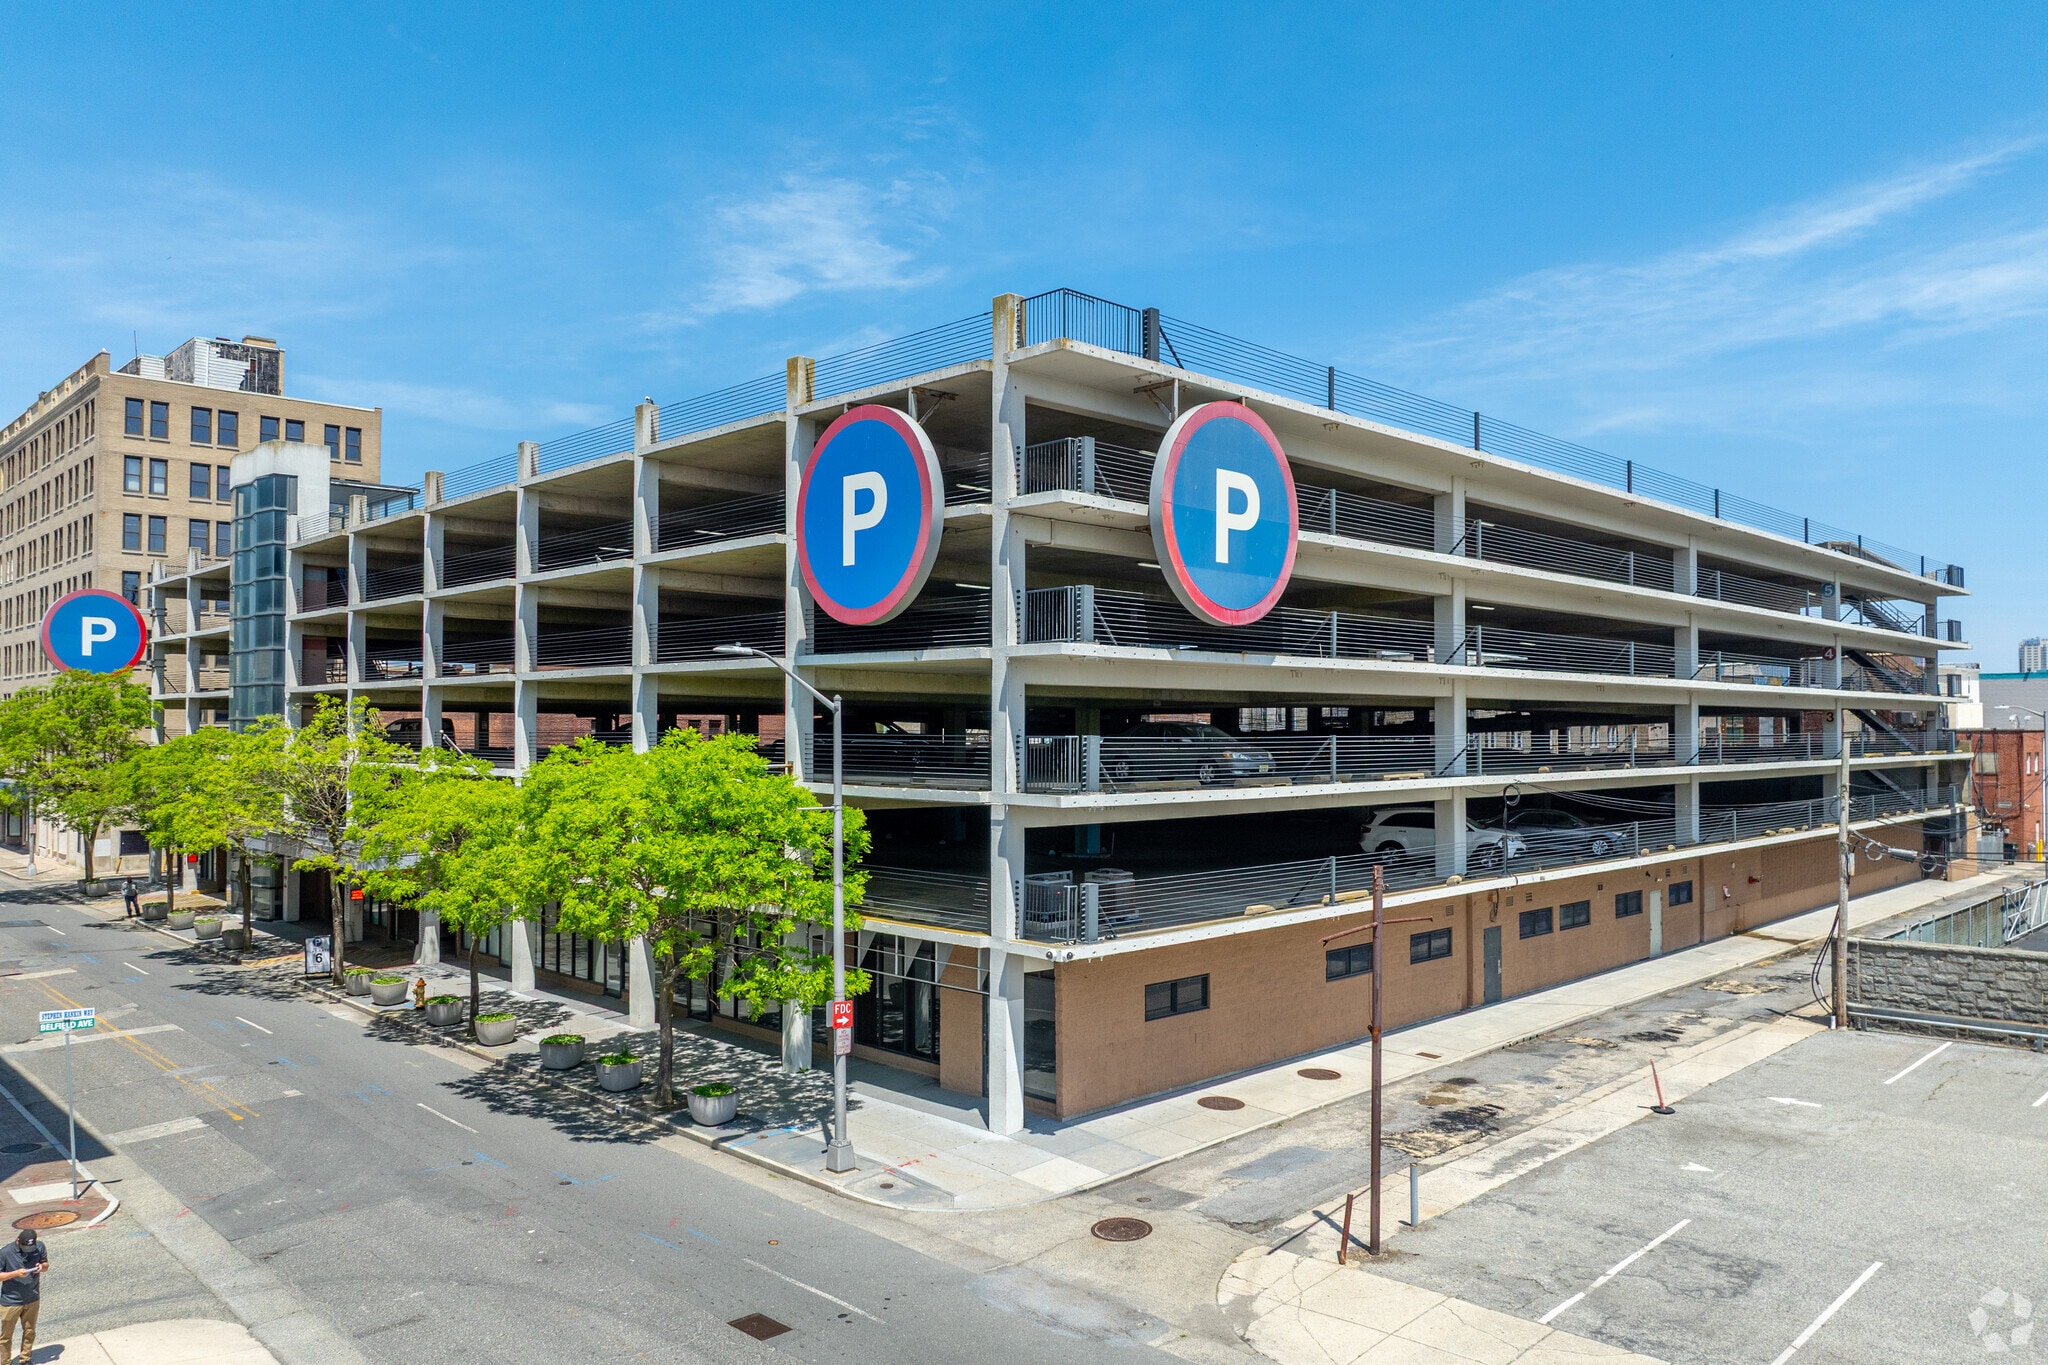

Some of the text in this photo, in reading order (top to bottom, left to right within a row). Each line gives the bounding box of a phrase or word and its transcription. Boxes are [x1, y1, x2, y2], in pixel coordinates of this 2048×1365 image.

[843, 471, 888, 567] P
[1216, 468, 1260, 564] P
[1824, 585, 1833, 597] 5
[82, 616, 117, 657] P
[1825, 649, 1833, 660] 4
[1825, 711, 1834, 723] 3
[835, 1003, 851, 1014] FDC
[40, 1020, 93, 1031] BELFIELD AVE
